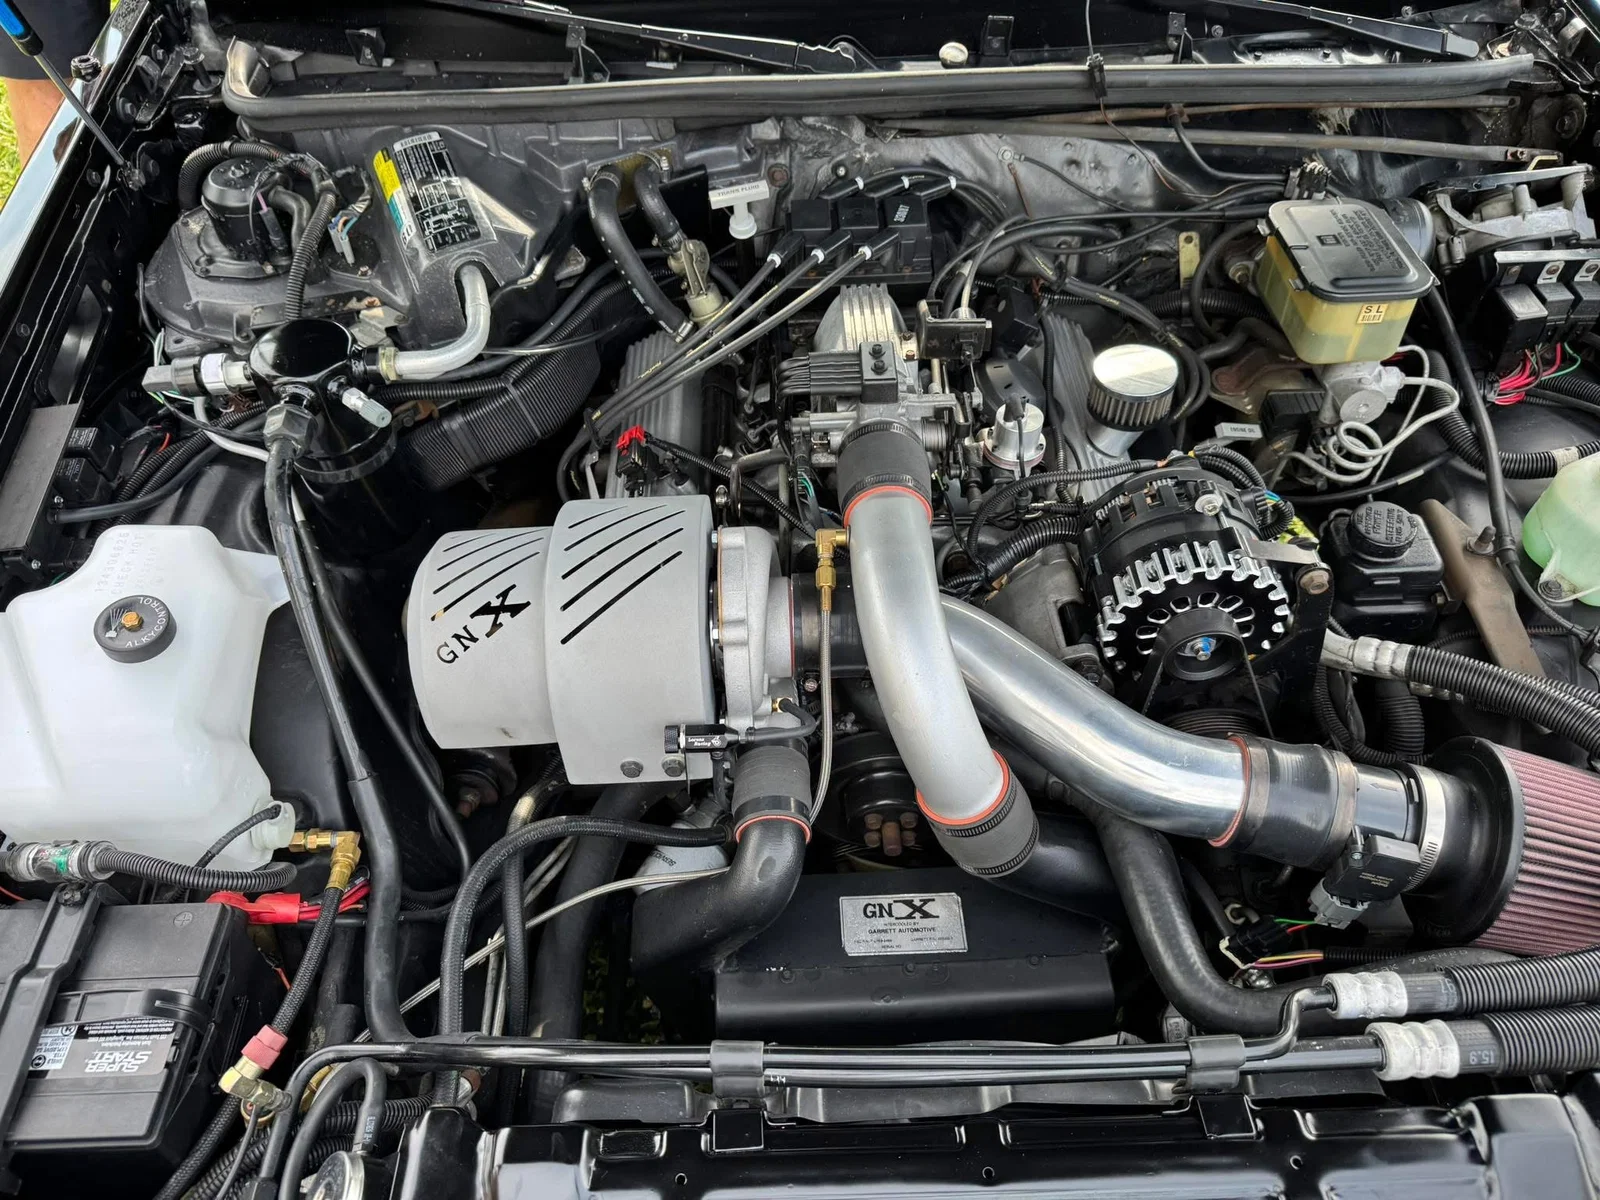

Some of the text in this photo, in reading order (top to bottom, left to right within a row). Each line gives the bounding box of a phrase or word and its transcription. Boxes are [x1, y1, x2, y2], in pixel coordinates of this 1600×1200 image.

[718, 184, 760, 196] TRANS FLUID
[1373, 509, 1383, 534] POWER
[437, 584, 531, 664] GNX
[863, 898, 940, 920] GNX
[91, 1050, 152, 1063] START
[1469, 1050, 1495, 1064] 15.9
[85, 1060, 139, 1073] SUPER
